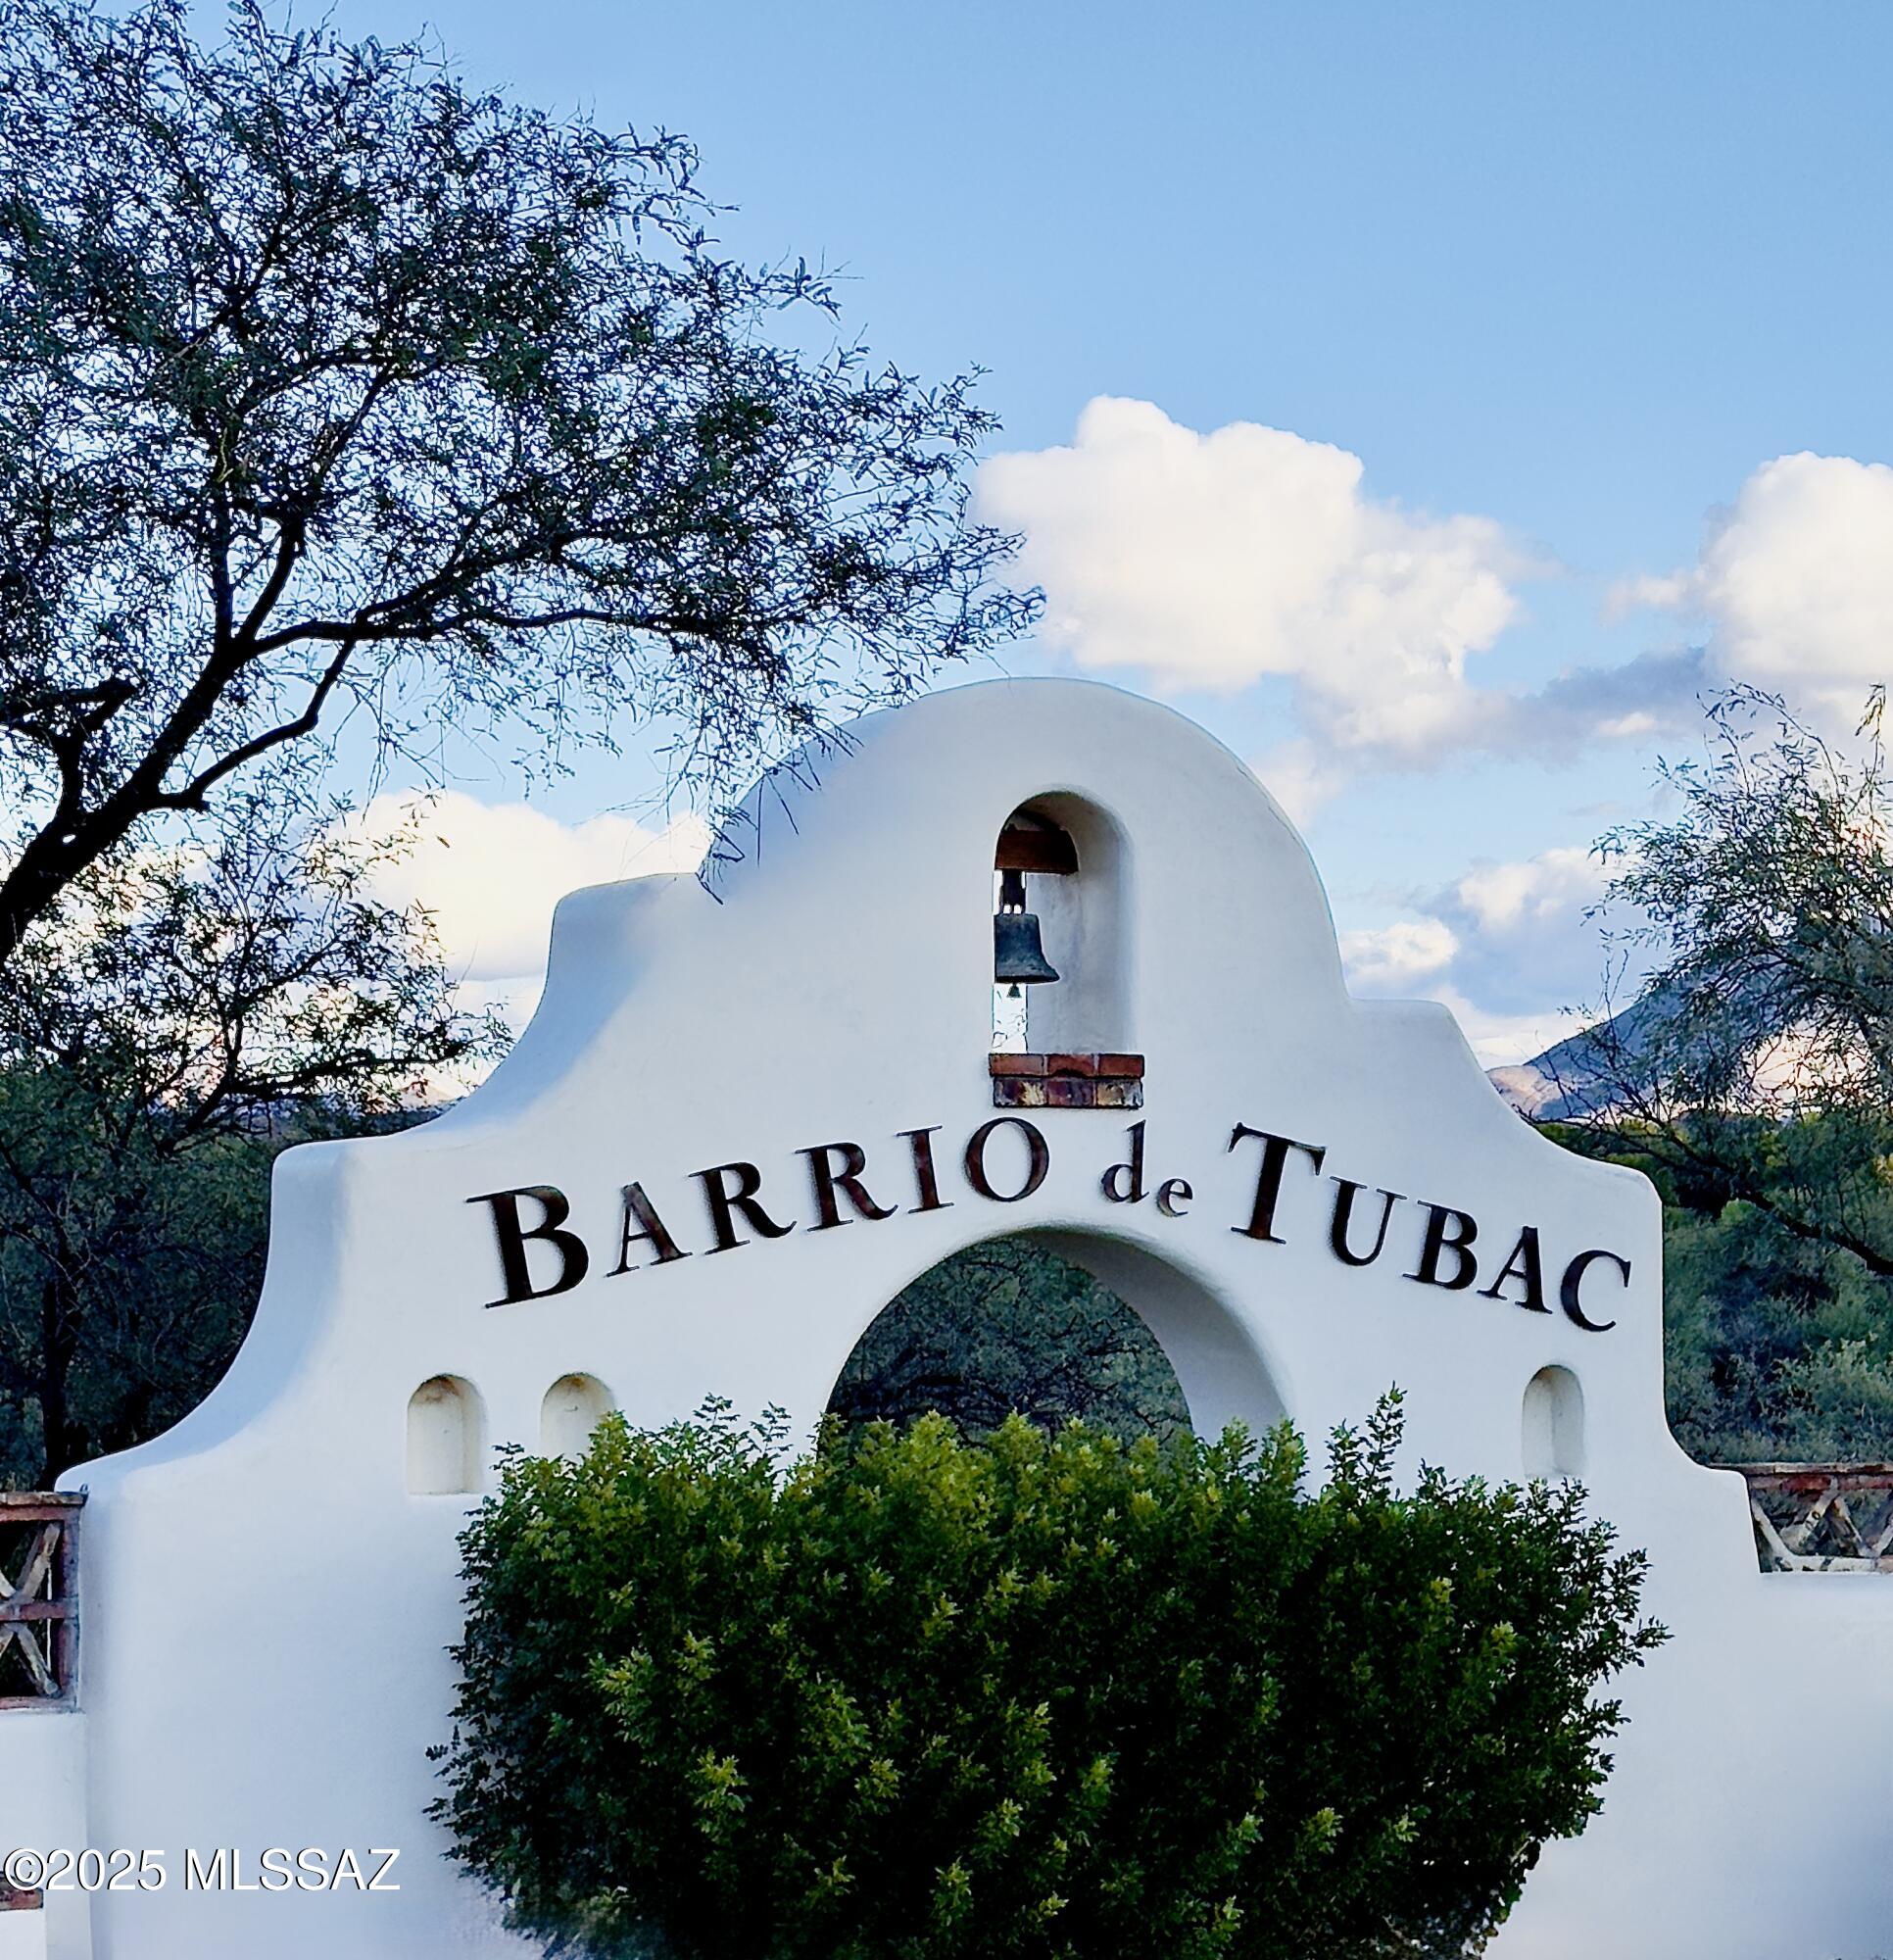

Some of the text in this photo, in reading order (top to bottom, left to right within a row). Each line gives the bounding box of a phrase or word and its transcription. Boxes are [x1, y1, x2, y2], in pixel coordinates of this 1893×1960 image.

[465, 1116, 1631, 1332] BARRIO de TUBAC
